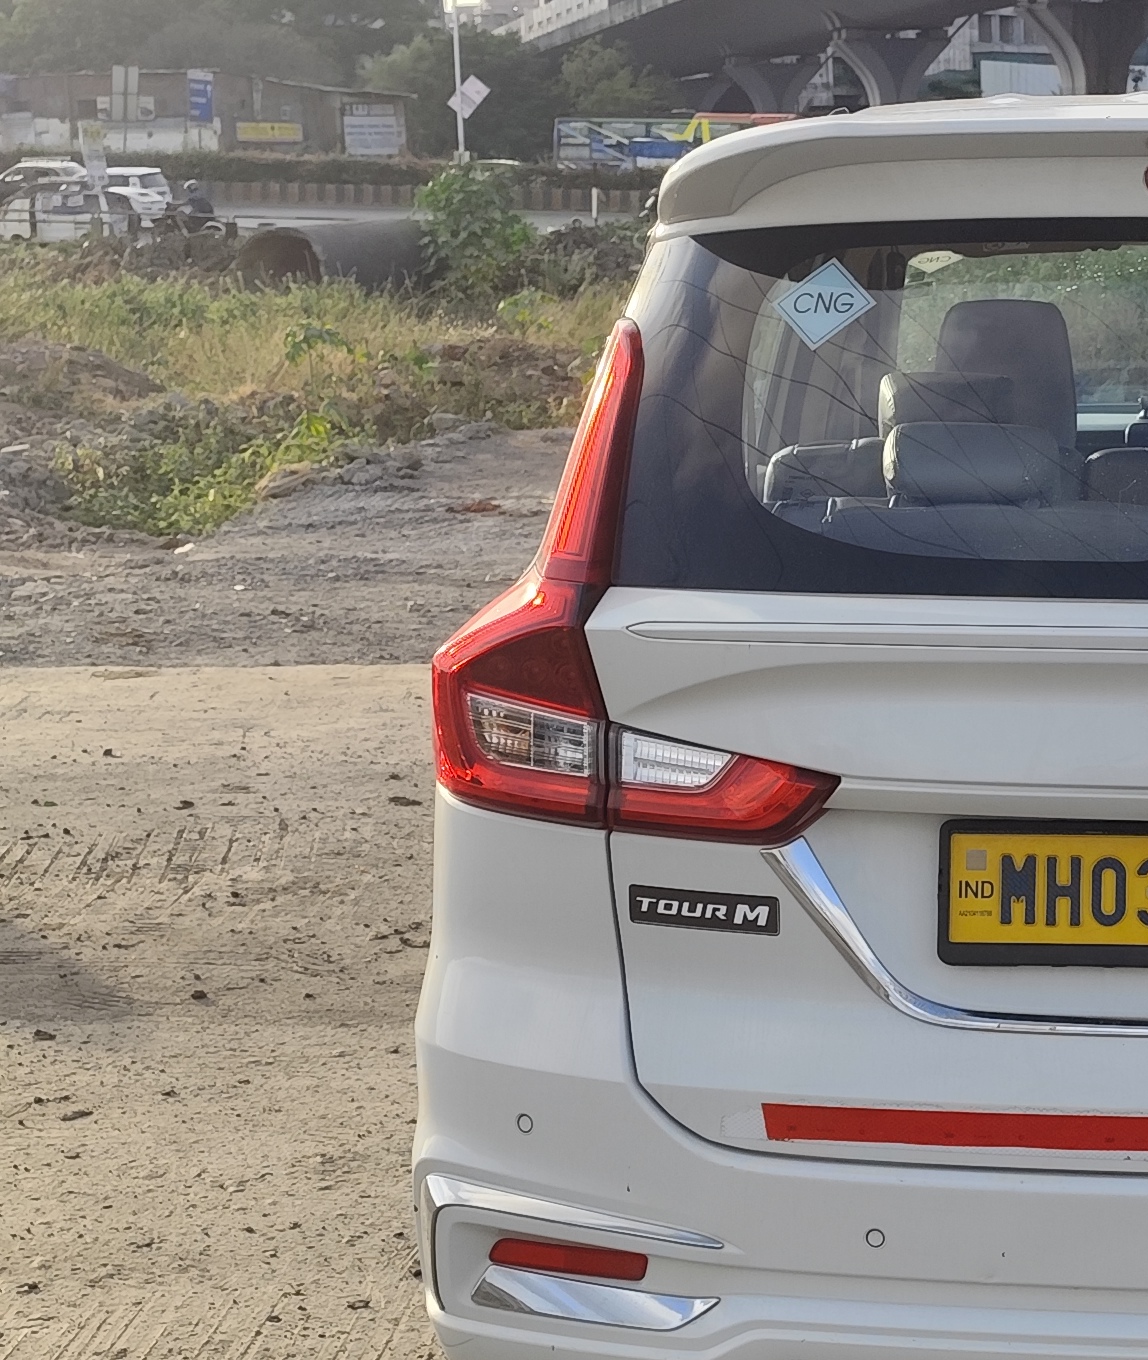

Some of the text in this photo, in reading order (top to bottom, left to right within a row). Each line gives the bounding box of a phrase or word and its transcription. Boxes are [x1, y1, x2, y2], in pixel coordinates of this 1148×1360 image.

[793, 291, 855, 314] CNG
[958, 880, 994, 899] IND
[635, 896, 770, 927] TOUR M
